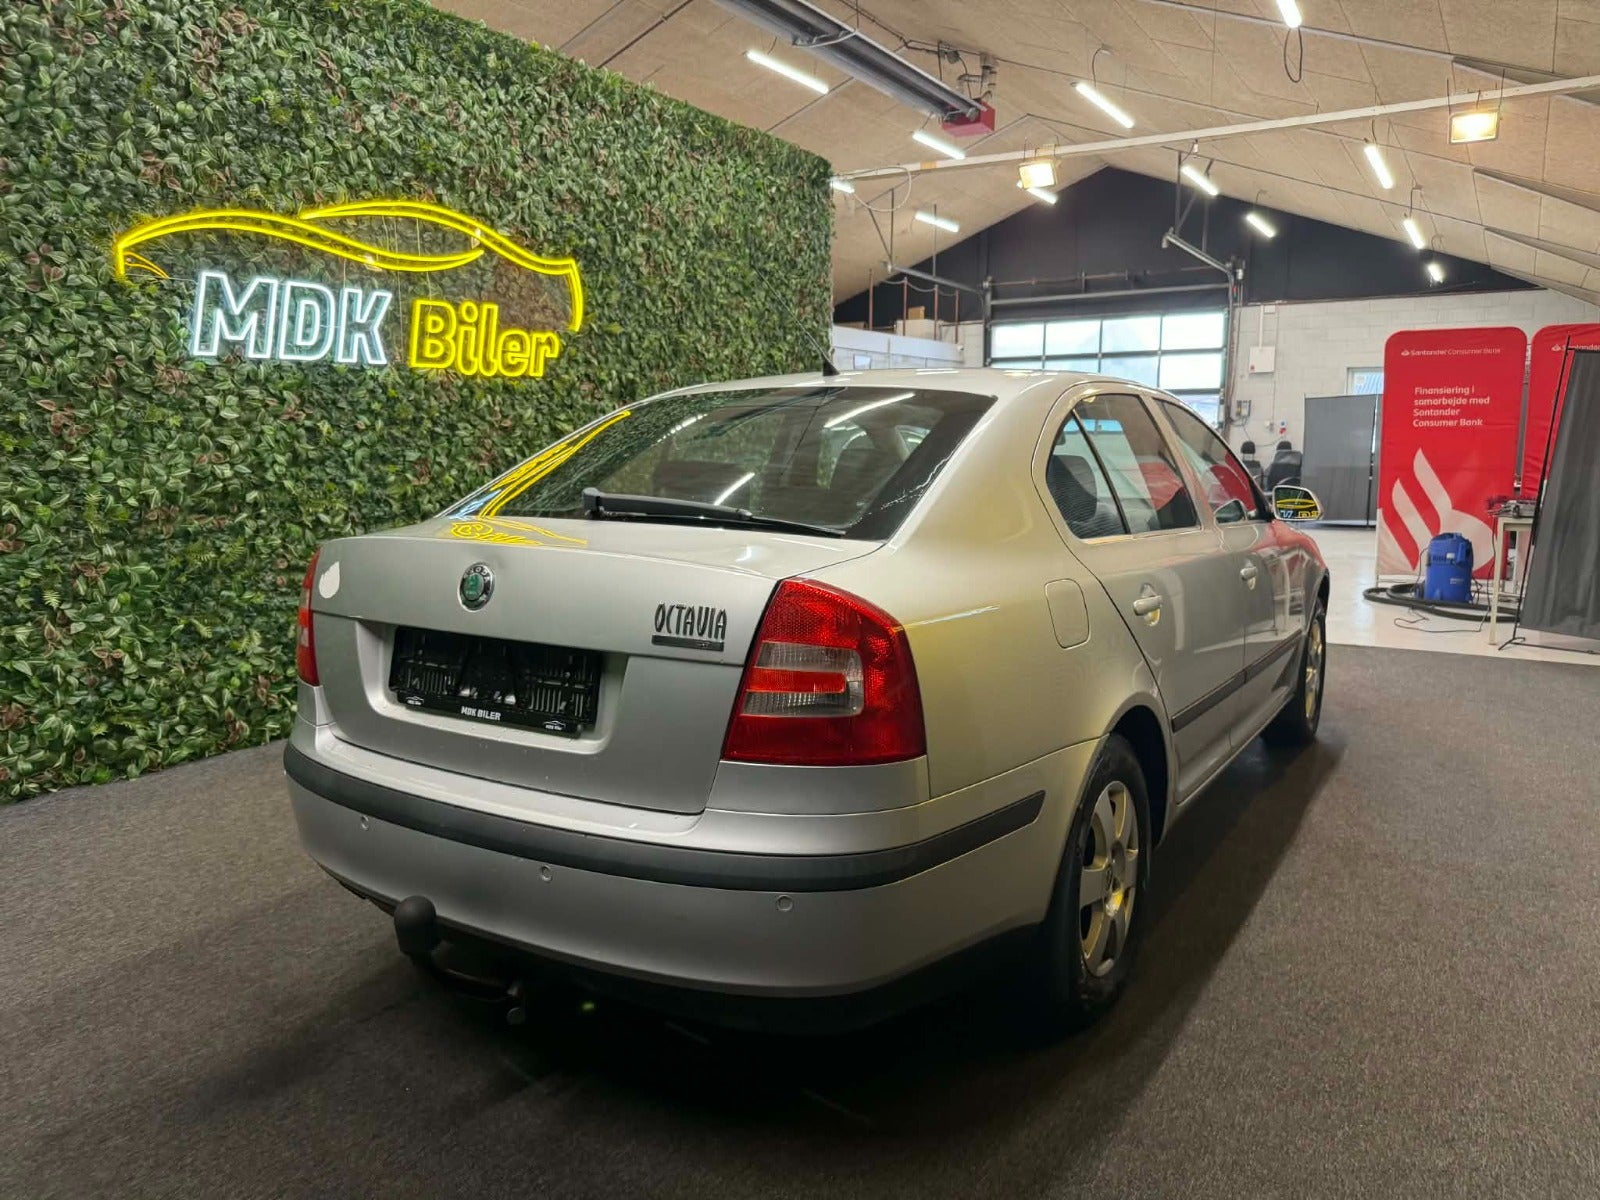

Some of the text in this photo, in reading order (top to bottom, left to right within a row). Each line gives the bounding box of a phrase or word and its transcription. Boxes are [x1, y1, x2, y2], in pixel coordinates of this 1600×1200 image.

[192, 271, 561, 377] MDK Biler
[1414, 386, 1470, 396] Finansiering
[1413, 395, 1491, 407] samarbejde med
[1412, 407, 1460, 417] Santander
[1412, 418, 1483, 428] Consumer Bank
[654, 602, 727, 640] OCTAVIA
[461, 706, 502, 721] MDK BILER
